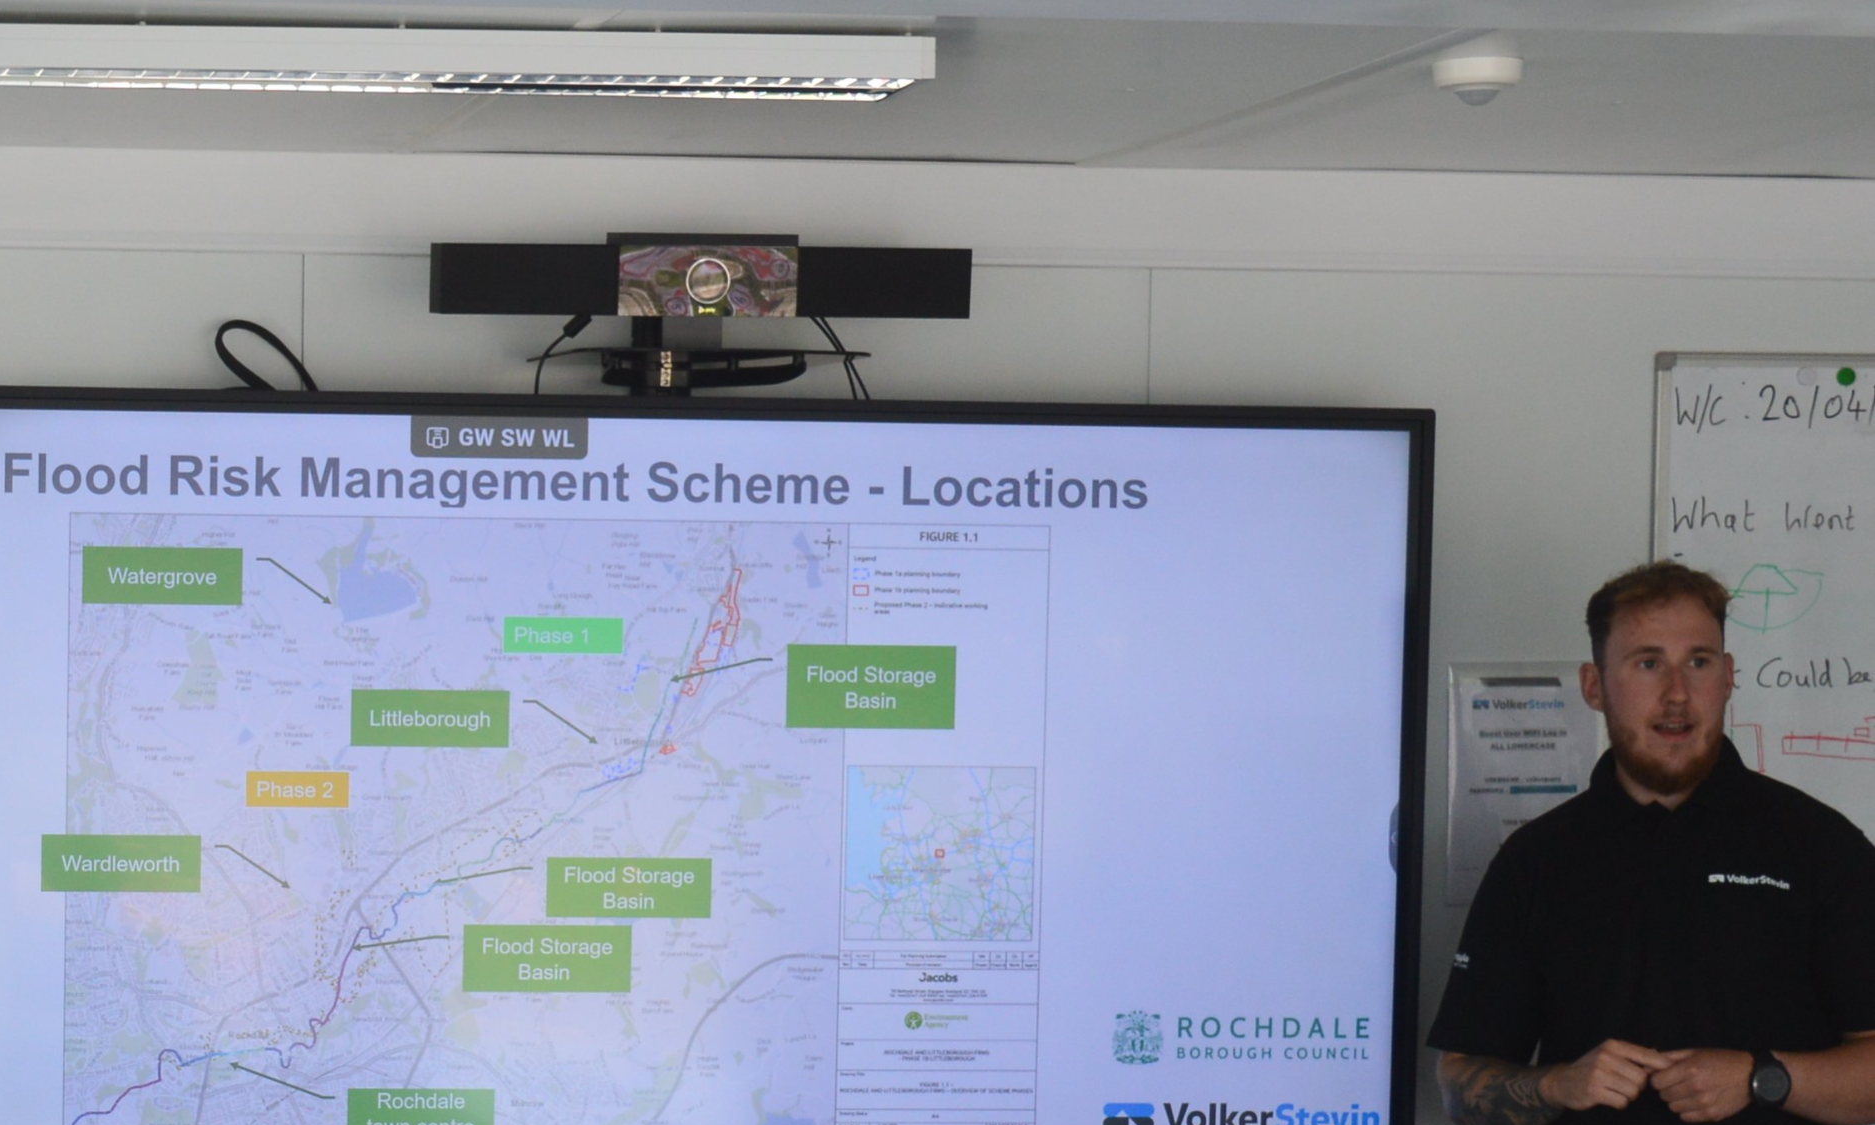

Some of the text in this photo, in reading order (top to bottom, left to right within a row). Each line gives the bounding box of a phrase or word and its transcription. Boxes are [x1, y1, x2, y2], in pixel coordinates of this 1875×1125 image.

[459, 427, 575, 448] GW SW WL
[3, 452, 1149, 511] Flood Risk Management Scheme - Locations
[1672, 496, 1855, 533] What Went
[919, 531, 978, 542] FIGURE 1.1
[107, 566, 218, 591] Watergrove
[514, 626, 590, 645] Phase 1
[806, 665, 937, 689] Flood Storage
[1757, 656, 1873, 689] Could be
[844, 691, 897, 710] Basin
[1492, 699, 1566, 710] VolkerStevin
[368, 708, 492, 731] Littleborough
[1490, 742, 1556, 751] ALL LOWERCASE
[256, 781, 334, 799] Phase 2
[61, 854, 181, 873] Wardleworth
[564, 866, 695, 888] Flood Storage
[1726, 874, 1790, 890] VolkerStevin
[602, 891, 655, 910] Basin
[482, 938, 613, 960] Flood Storage
[517, 963, 571, 981] Basin
[919, 972, 959, 983] Jacobs
[924, 1021, 949, 1029] Agency
[1178, 1017, 1370, 1038] ROCHDALE
[1177, 1047, 1369, 1060] BOROUGH COUNCIL
[377, 1092, 466, 1111] Rochdale
